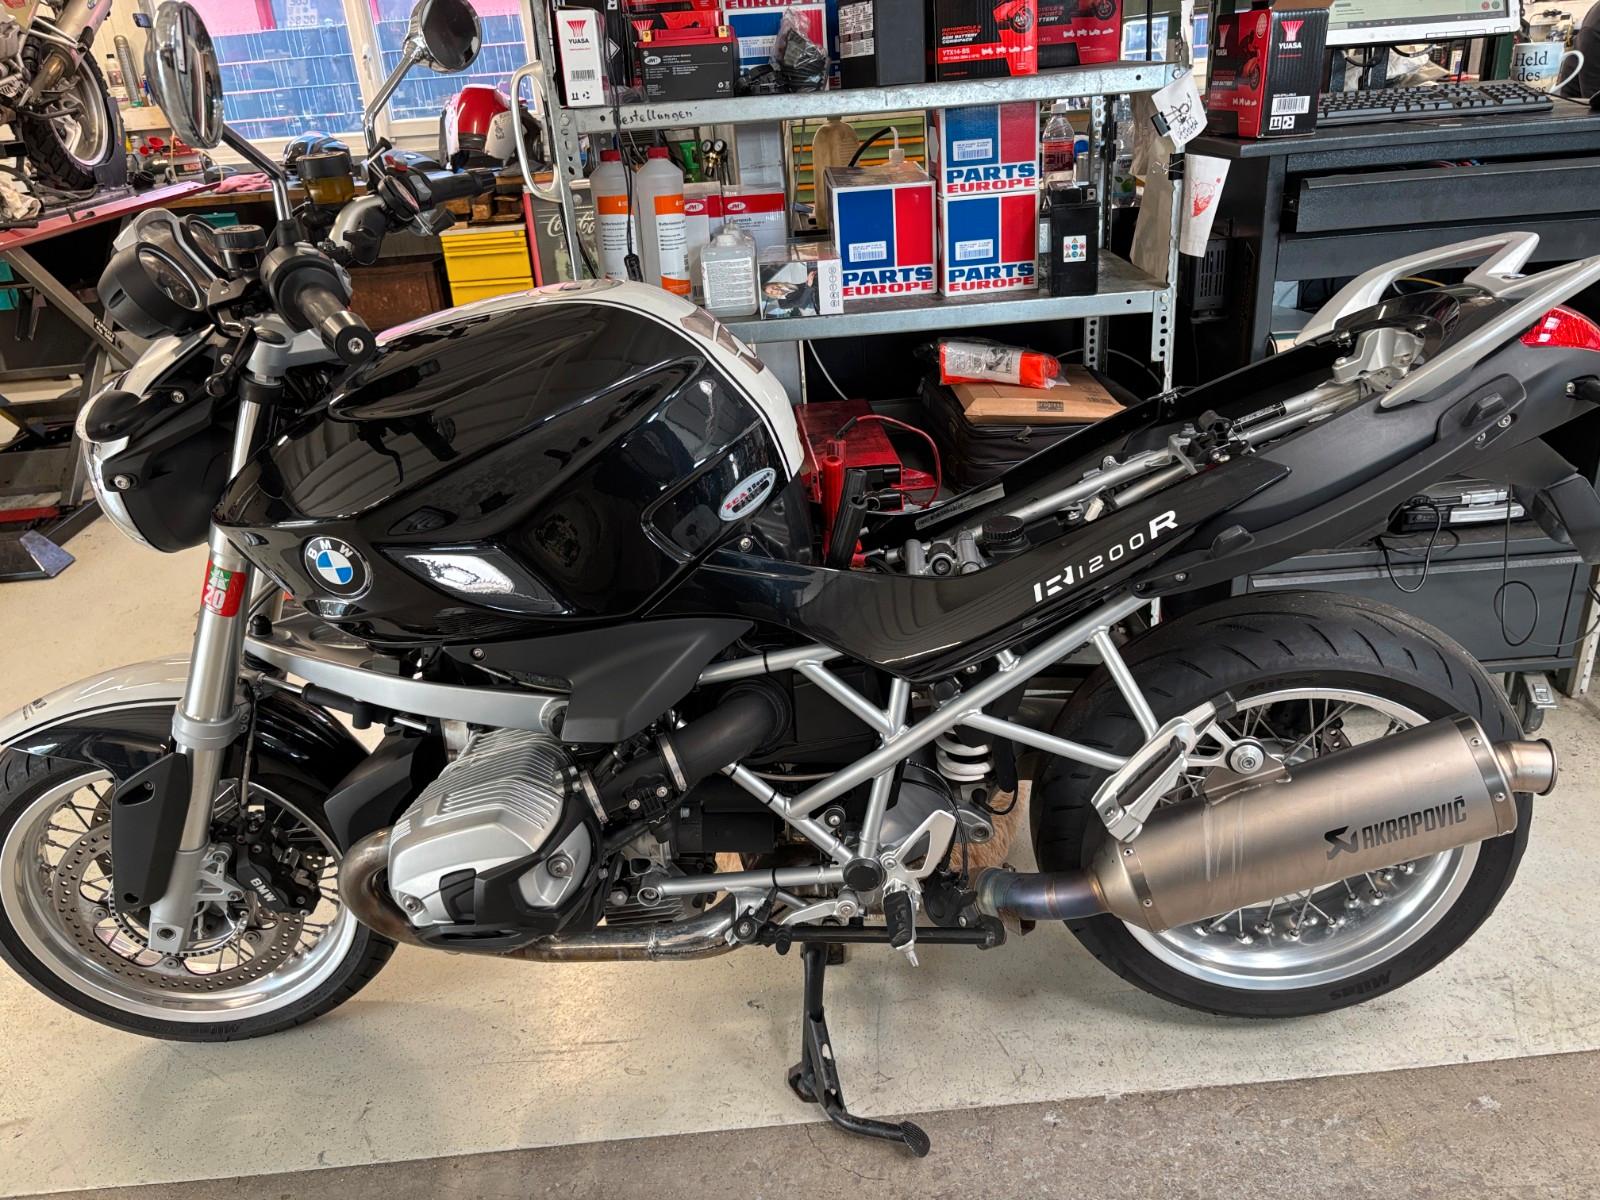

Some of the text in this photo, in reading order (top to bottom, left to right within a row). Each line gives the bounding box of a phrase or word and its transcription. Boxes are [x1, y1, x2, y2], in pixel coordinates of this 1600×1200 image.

[1514, 50, 1548, 67] Held
[1517, 68, 1541, 82] des
[946, 162, 1036, 184] PARTS
[946, 177, 1036, 194] EUROPE
[842, 266, 933, 287] PARTS
[948, 262, 1035, 282] PARTS
[842, 280, 933, 297] EUROPE
[948, 276, 1035, 292] EUROPE
[307, 539, 354, 560] BMW
[1362, 795, 1467, 850] AKRAPOVIČ
[250, 877, 277, 902] BMW
